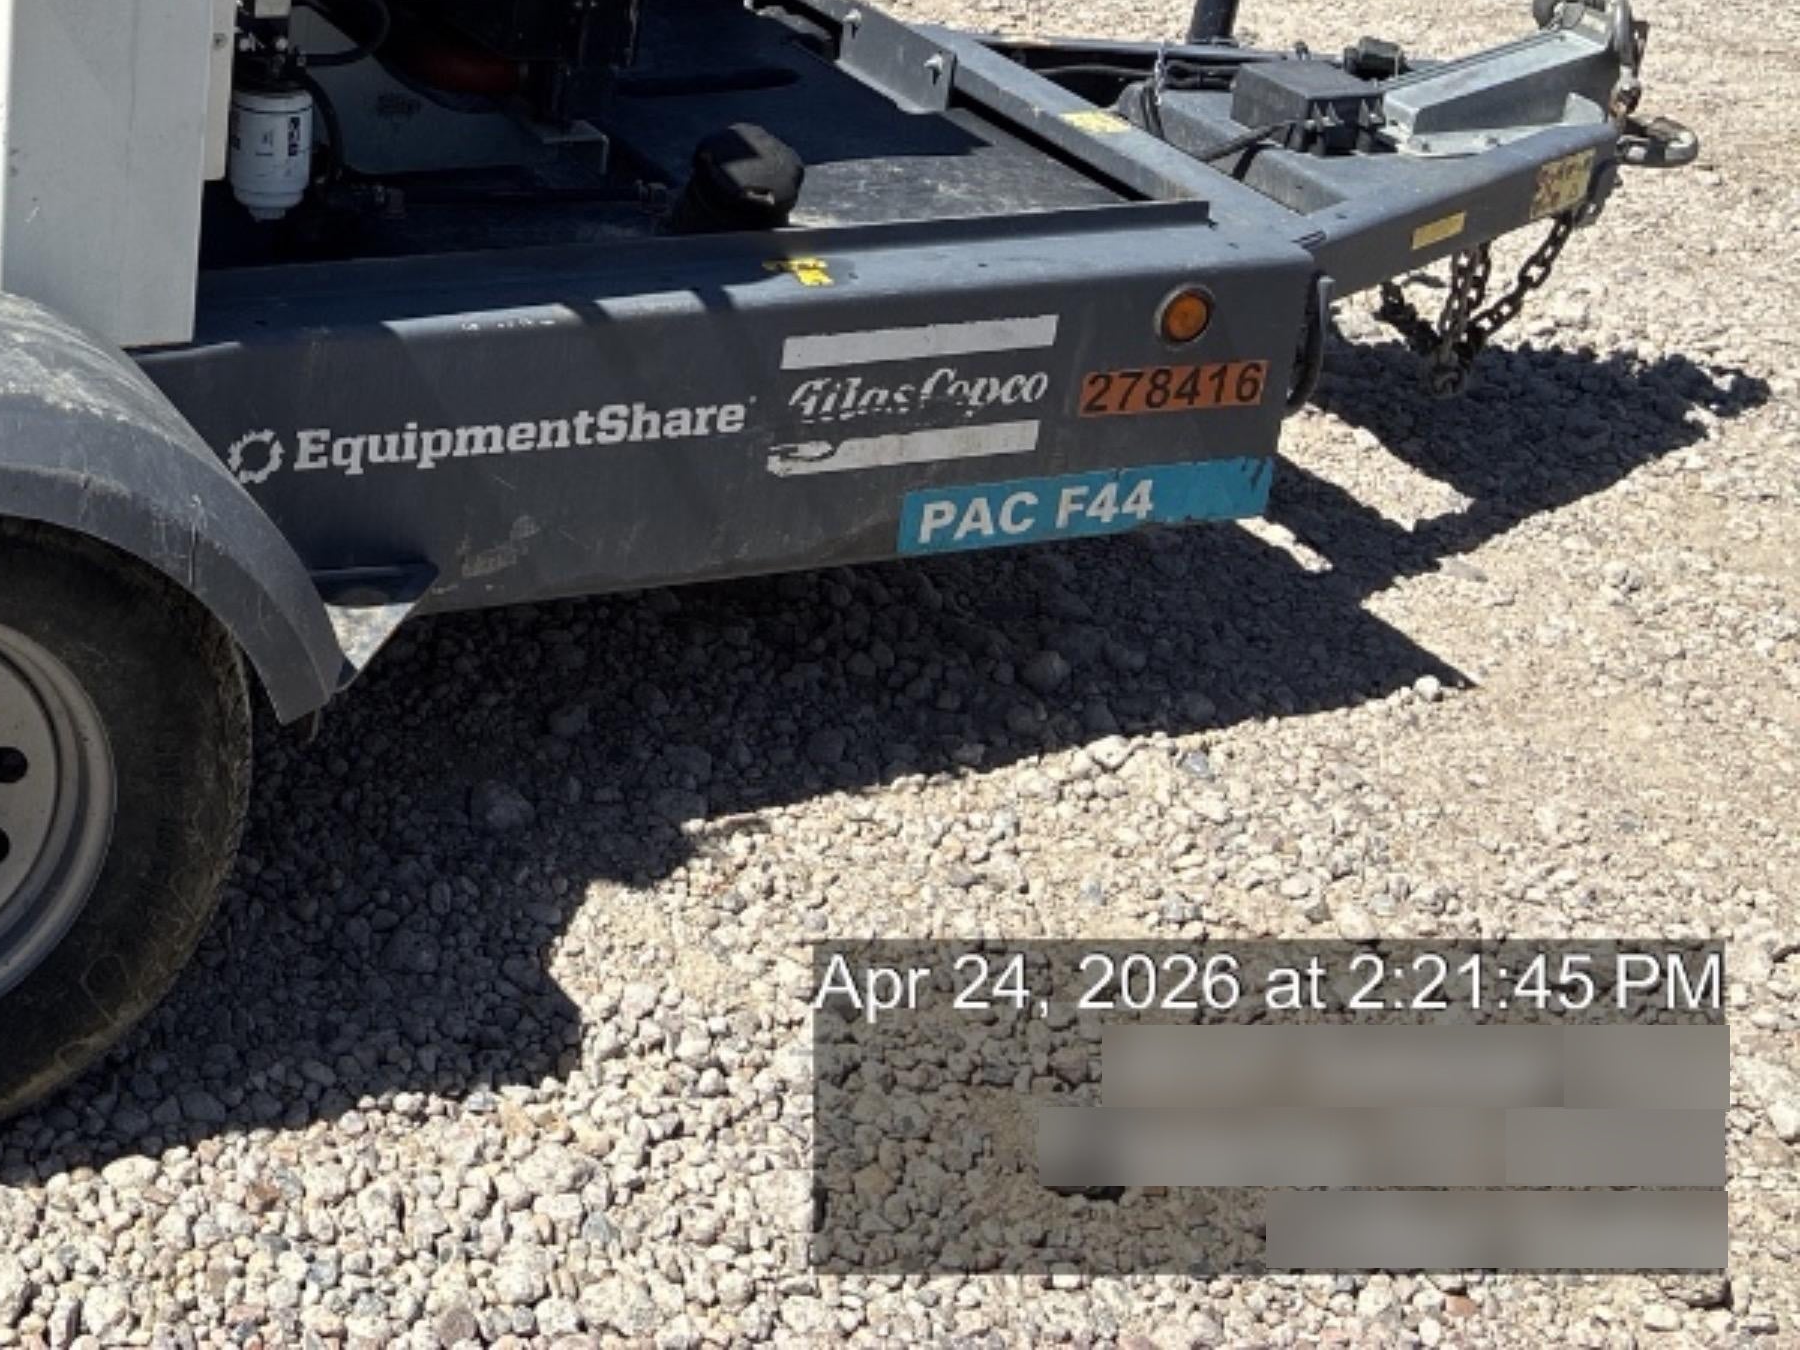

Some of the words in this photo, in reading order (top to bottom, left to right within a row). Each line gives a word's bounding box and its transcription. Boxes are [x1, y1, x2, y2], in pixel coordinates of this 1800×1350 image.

[1083, 360, 1262, 413] 278416
[293, 402, 746, 476] EquipmentShare
[918, 491, 1039, 545] PAC
[1055, 478, 1155, 530] F44
